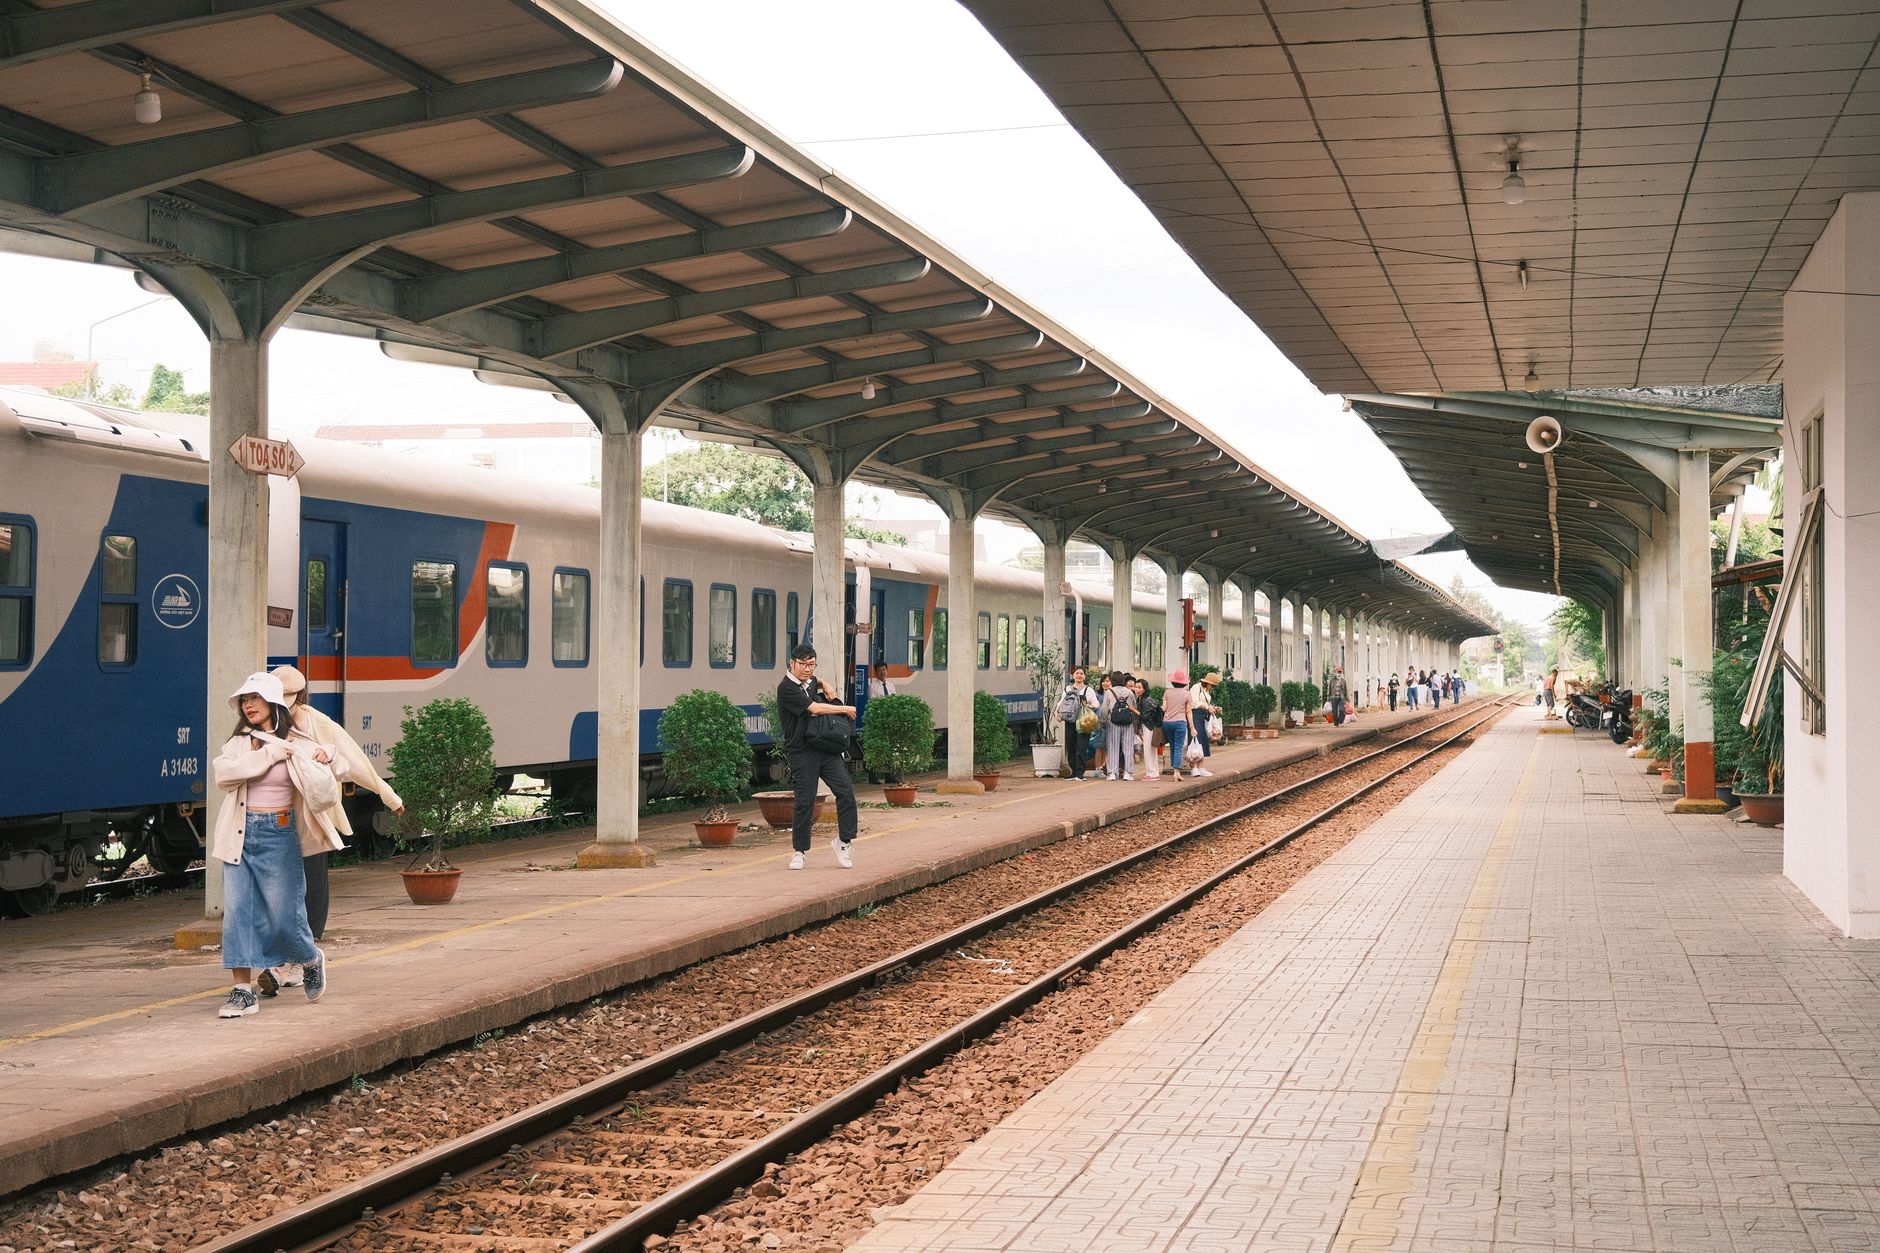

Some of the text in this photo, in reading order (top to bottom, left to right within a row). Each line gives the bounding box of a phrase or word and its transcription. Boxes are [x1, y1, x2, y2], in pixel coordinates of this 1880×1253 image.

[239, 440, 243, 462] 1
[249, 441, 269, 466] TOA
[289, 450, 295, 471] 2
[362, 715, 372, 730] SRT
[177, 727, 190, 744] SRT
[161, 757, 198, 777] A 31483
